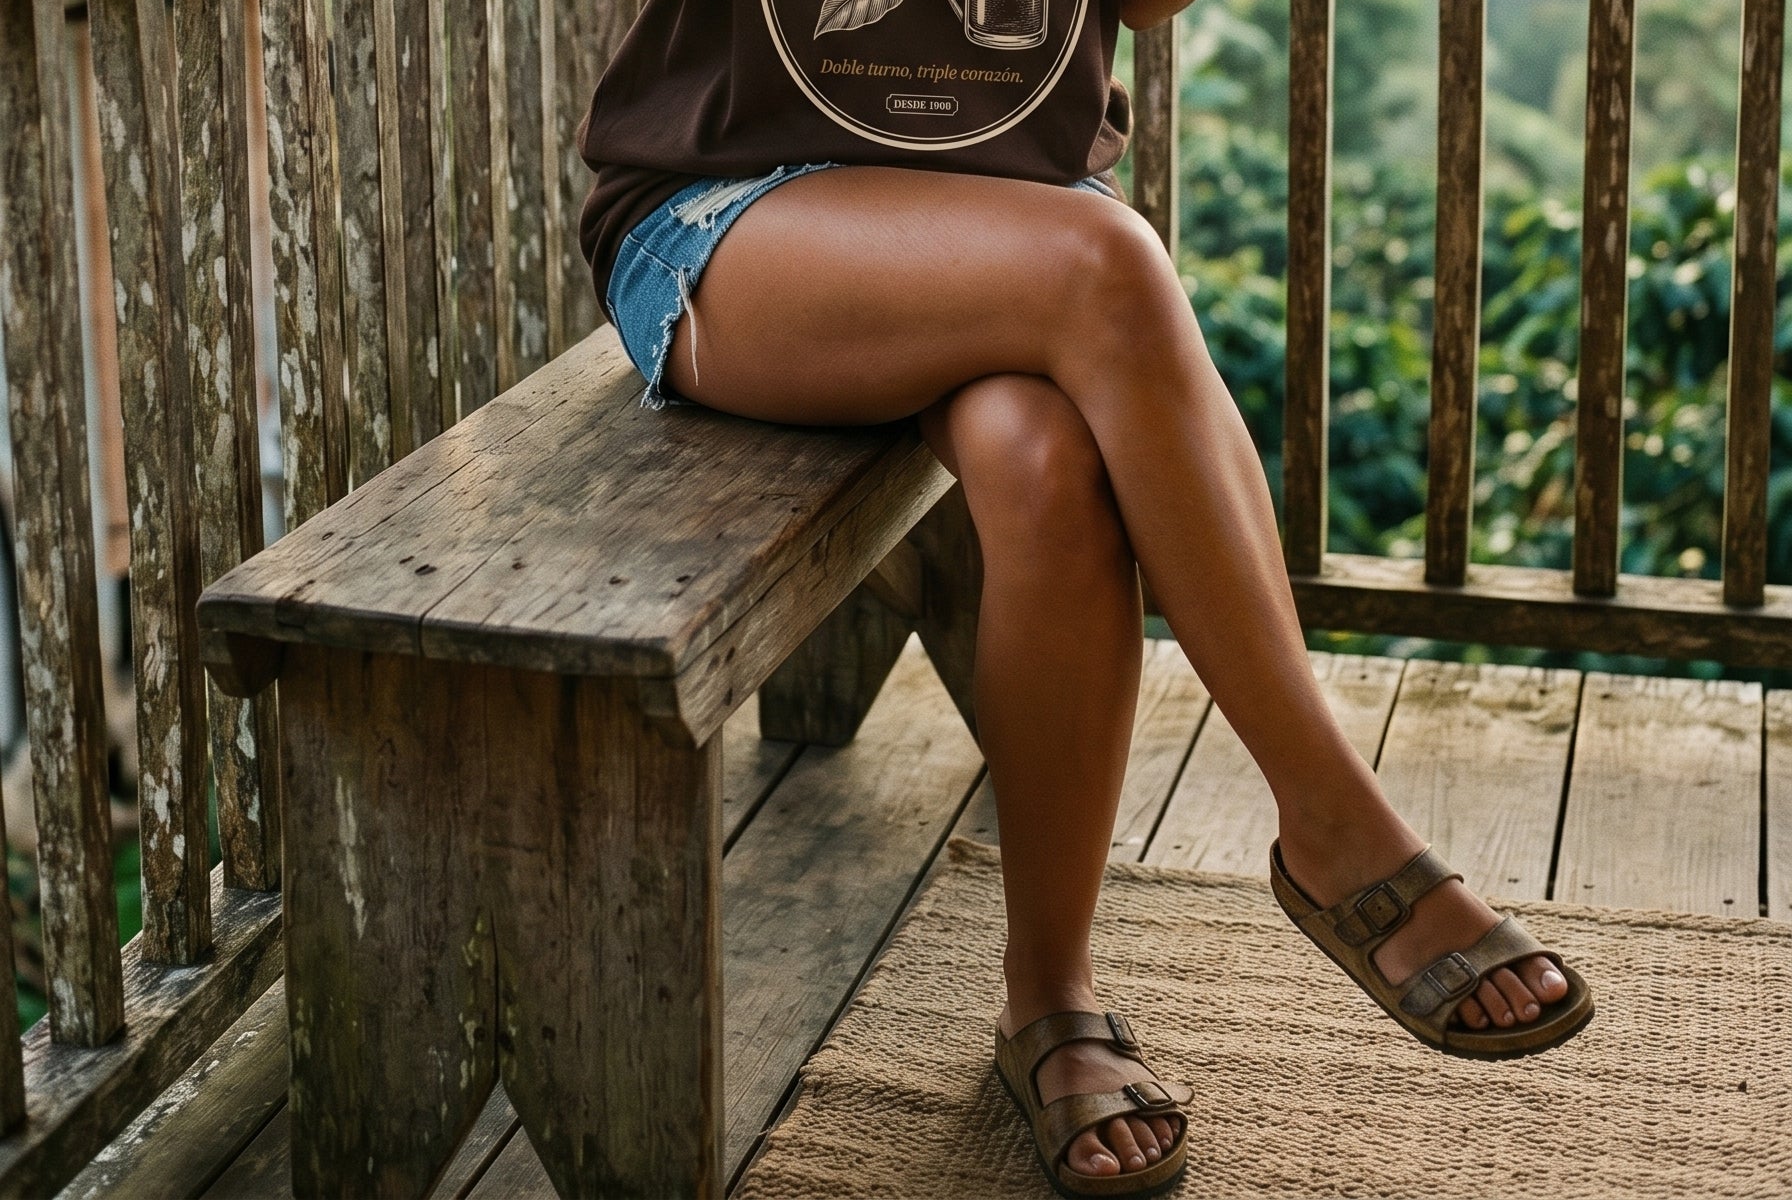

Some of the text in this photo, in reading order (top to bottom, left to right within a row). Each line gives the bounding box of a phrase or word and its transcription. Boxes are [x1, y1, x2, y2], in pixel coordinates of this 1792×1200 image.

[820, 58, 1024, 84] Doble turno, triple corazón.
[893, 99, 927, 110] DESDE
